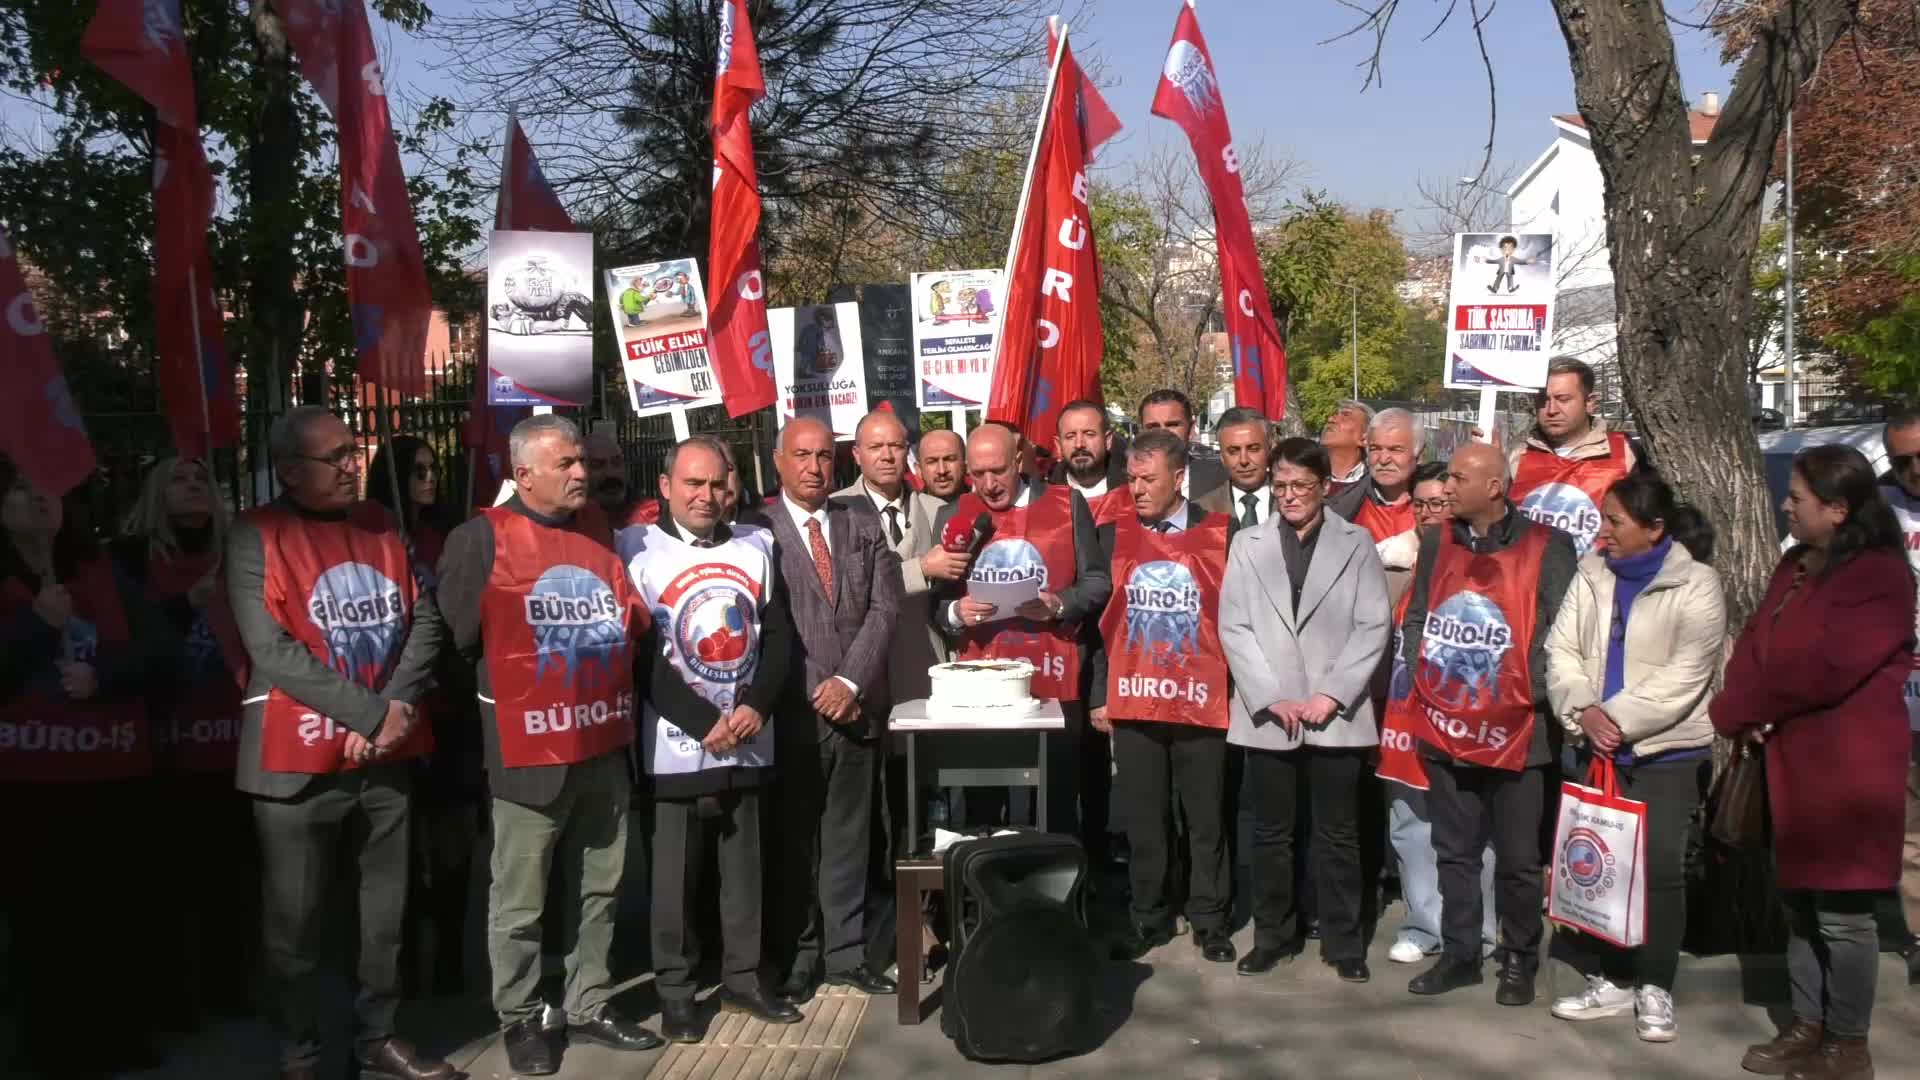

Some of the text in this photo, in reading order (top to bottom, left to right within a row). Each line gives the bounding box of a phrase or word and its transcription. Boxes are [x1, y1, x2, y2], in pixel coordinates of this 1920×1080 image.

[668, 330, 703, 349] ELİNİ
[529, 592, 617, 618] BÜRO-İŞ
[1118, 673, 1208, 709] BÜRO-İŞ
